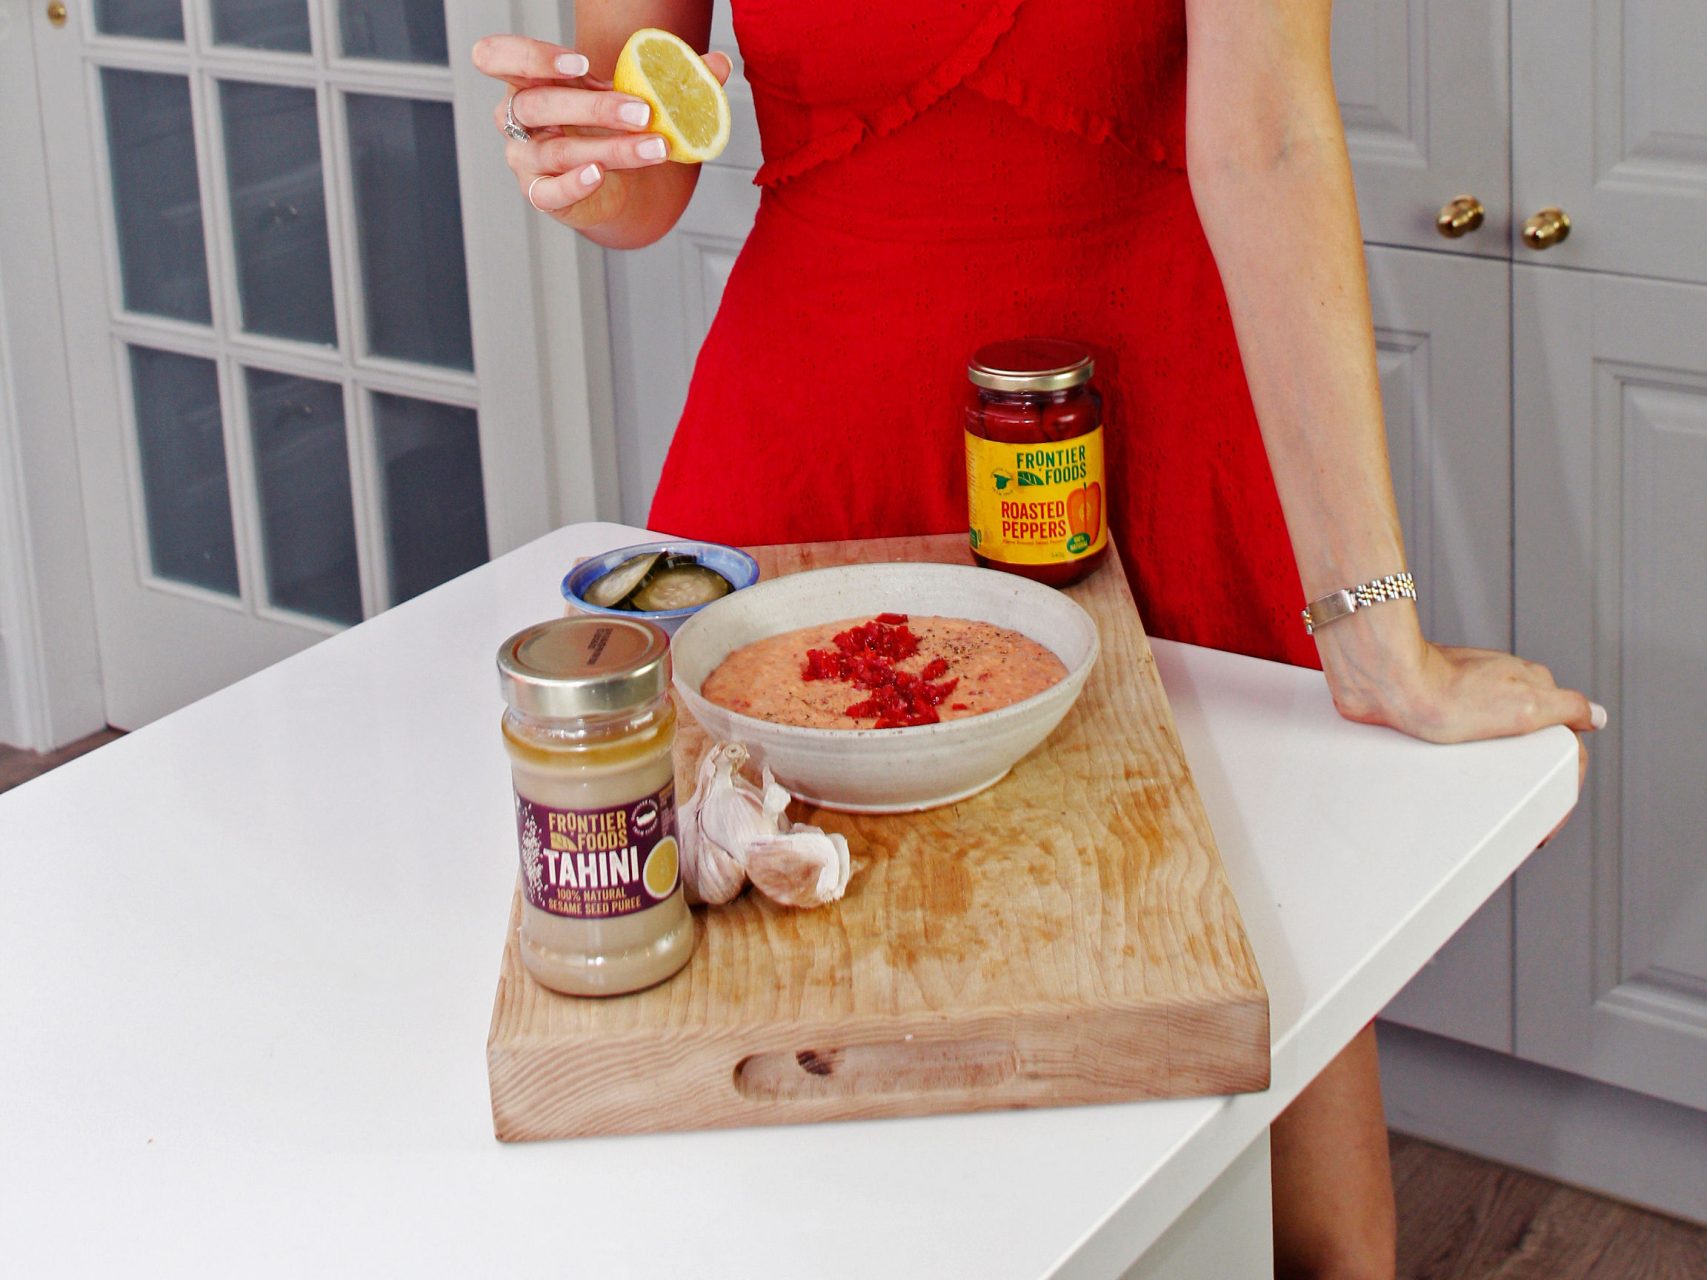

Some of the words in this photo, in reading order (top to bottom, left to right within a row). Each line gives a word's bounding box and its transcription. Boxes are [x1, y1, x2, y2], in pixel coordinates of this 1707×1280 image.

[1017, 445, 1086, 469] FRONTIER
[1045, 462, 1087, 485] FOODS
[1001, 501, 1065, 520] ROASTED
[1002, 520, 1067, 539] PEPPERS
[548, 810, 627, 833] FRONTIER
[577, 829, 628, 852] FOODS
[543, 845, 640, 888] TAHINI
[557, 888, 581, 901] 100%
[583, 887, 627, 902] NATURAL
[548, 898, 583, 915] SESAME
[585, 901, 610, 915] SEED
